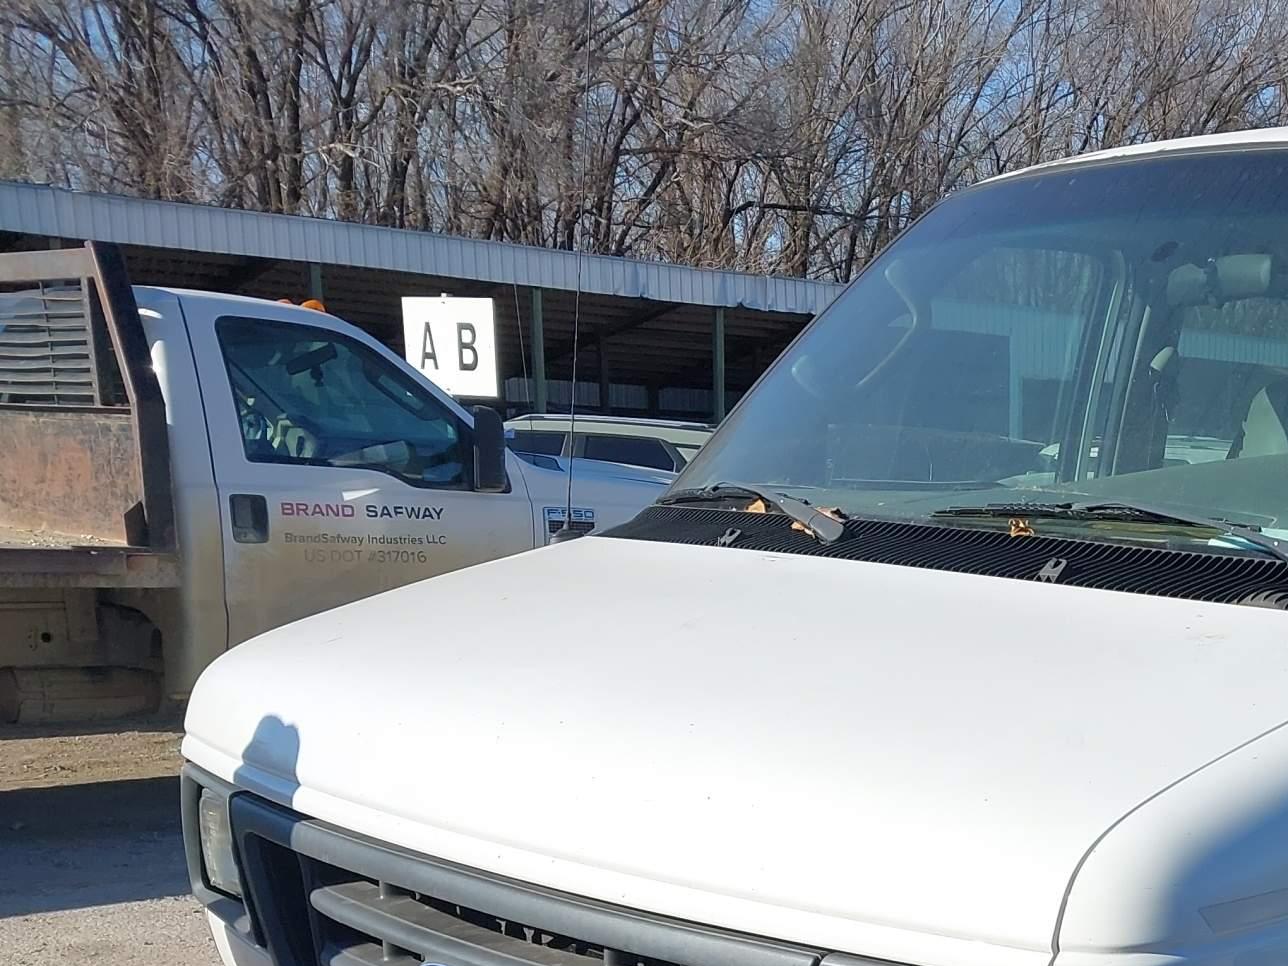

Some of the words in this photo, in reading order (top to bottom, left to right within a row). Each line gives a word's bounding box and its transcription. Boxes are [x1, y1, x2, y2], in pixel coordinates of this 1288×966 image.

[420, 321, 439, 370] A
[456, 322, 479, 371] B
[281, 502, 355, 518] BRAND
[365, 504, 444, 520] SAFWAY
[284, 532, 364, 547] BrandSafway
[368, 533, 424, 545] Industries
[426, 535, 447, 545] LLC
[304, 549, 325, 563] US
[331, 550, 362, 563] DOT
[368, 550, 427, 564] #317016
